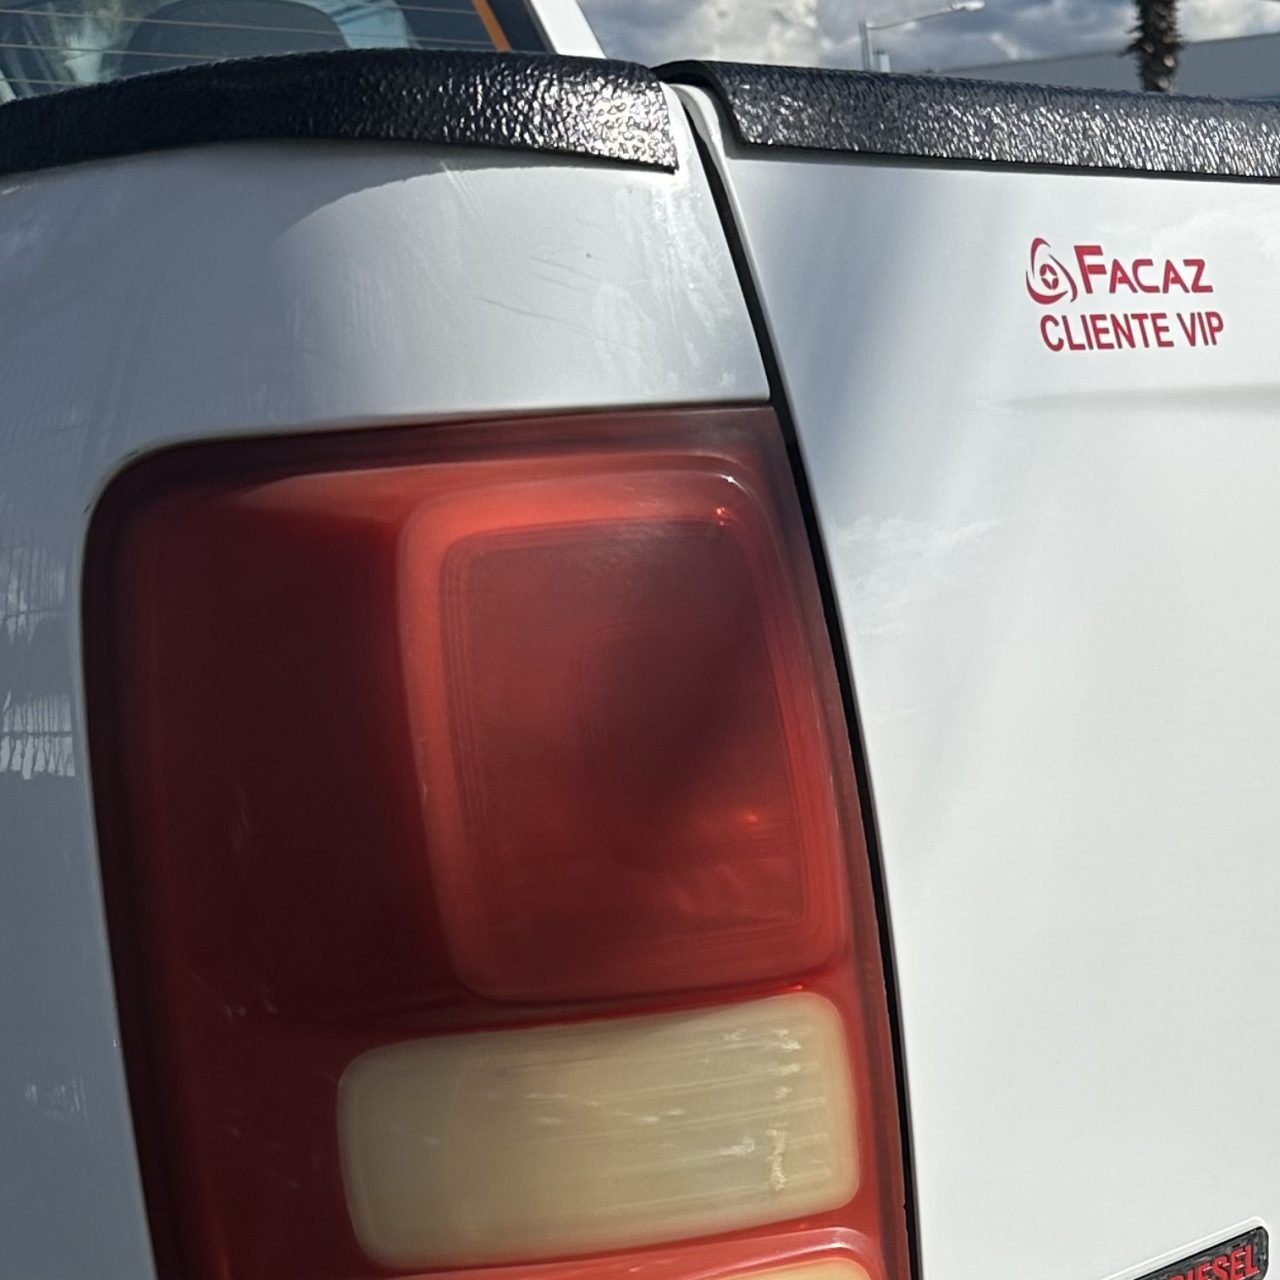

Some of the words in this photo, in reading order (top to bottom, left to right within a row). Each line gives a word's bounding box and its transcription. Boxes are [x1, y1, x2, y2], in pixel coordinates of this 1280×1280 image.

[1074, 245, 1213, 294] FACAZ
[1040, 312, 1174, 352] CLIENTE
[1176, 311, 1224, 346] VIP
